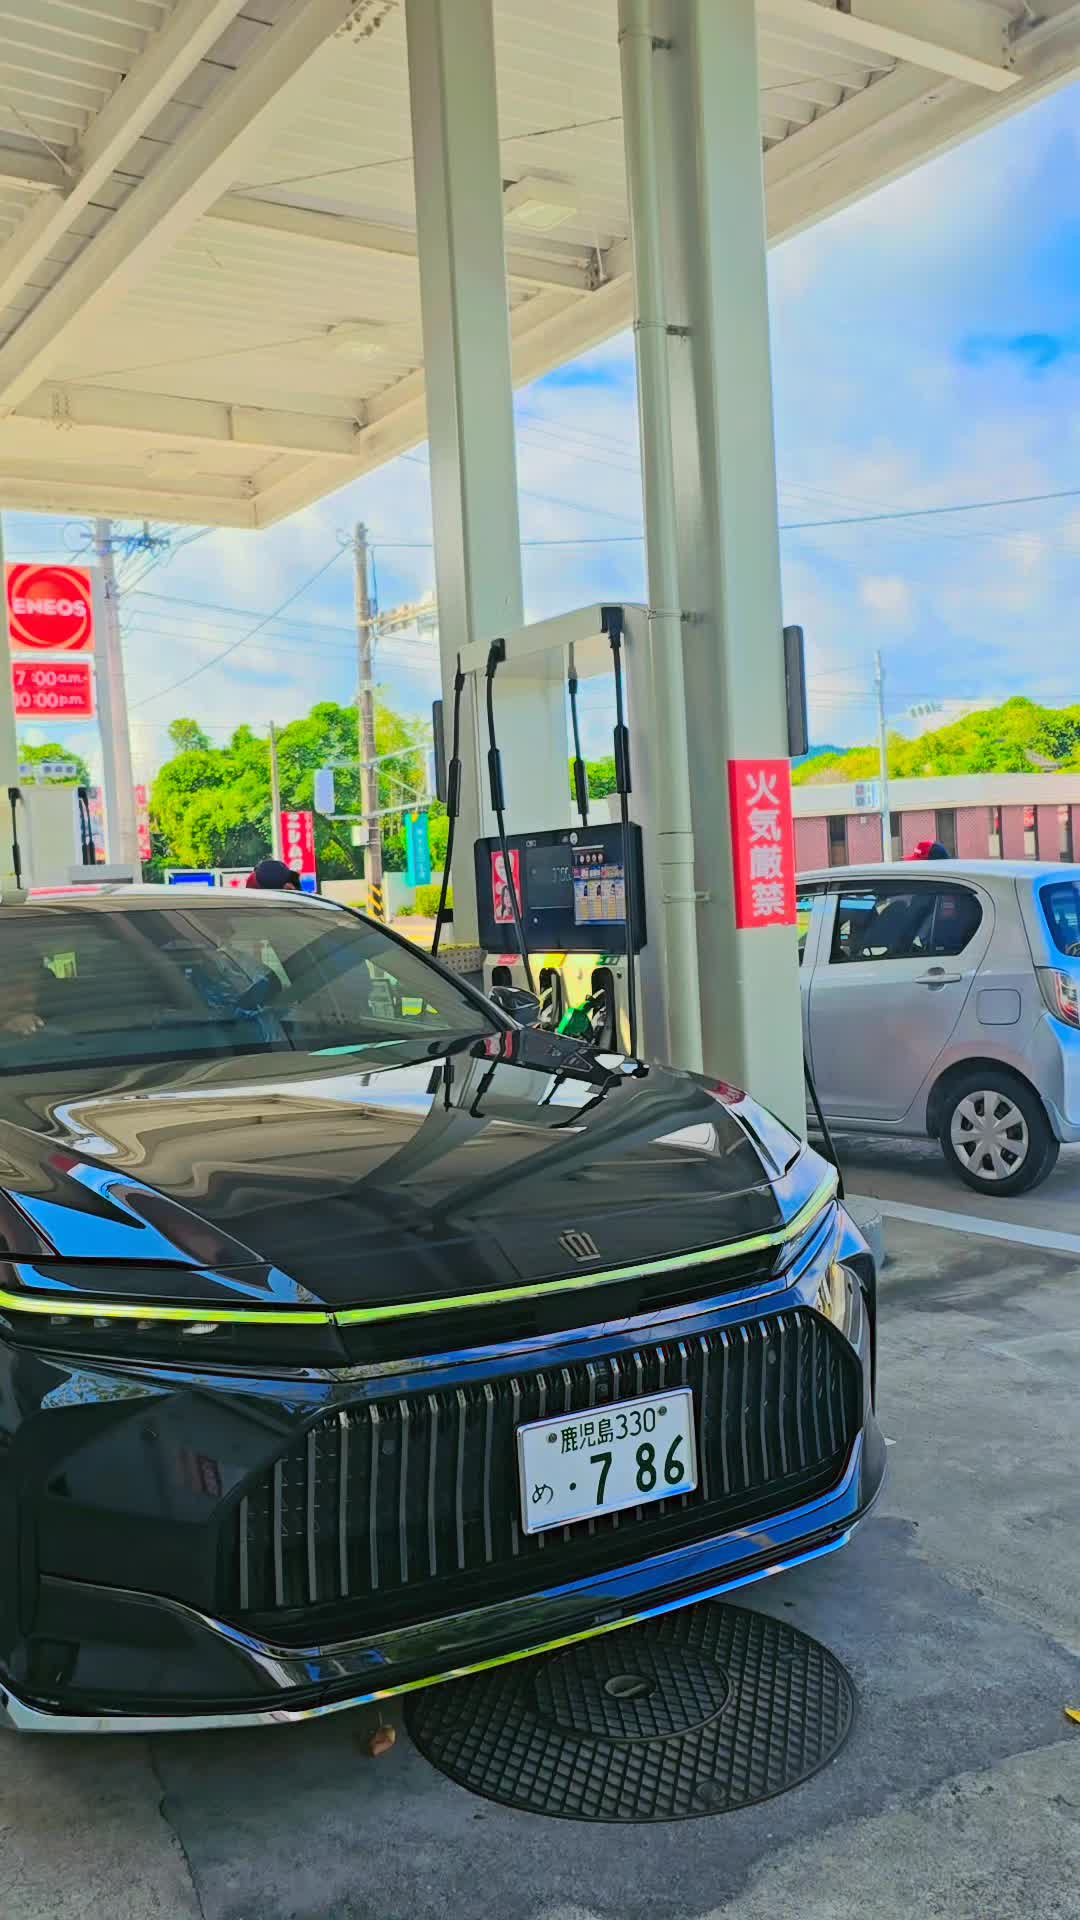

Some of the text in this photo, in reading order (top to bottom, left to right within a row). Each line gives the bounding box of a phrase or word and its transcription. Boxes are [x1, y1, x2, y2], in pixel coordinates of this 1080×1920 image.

[12, 597, 87, 617] ENEOS
[746, 770, 785, 917] 火気厳禁
[532, 1483, 554, 1504] め
